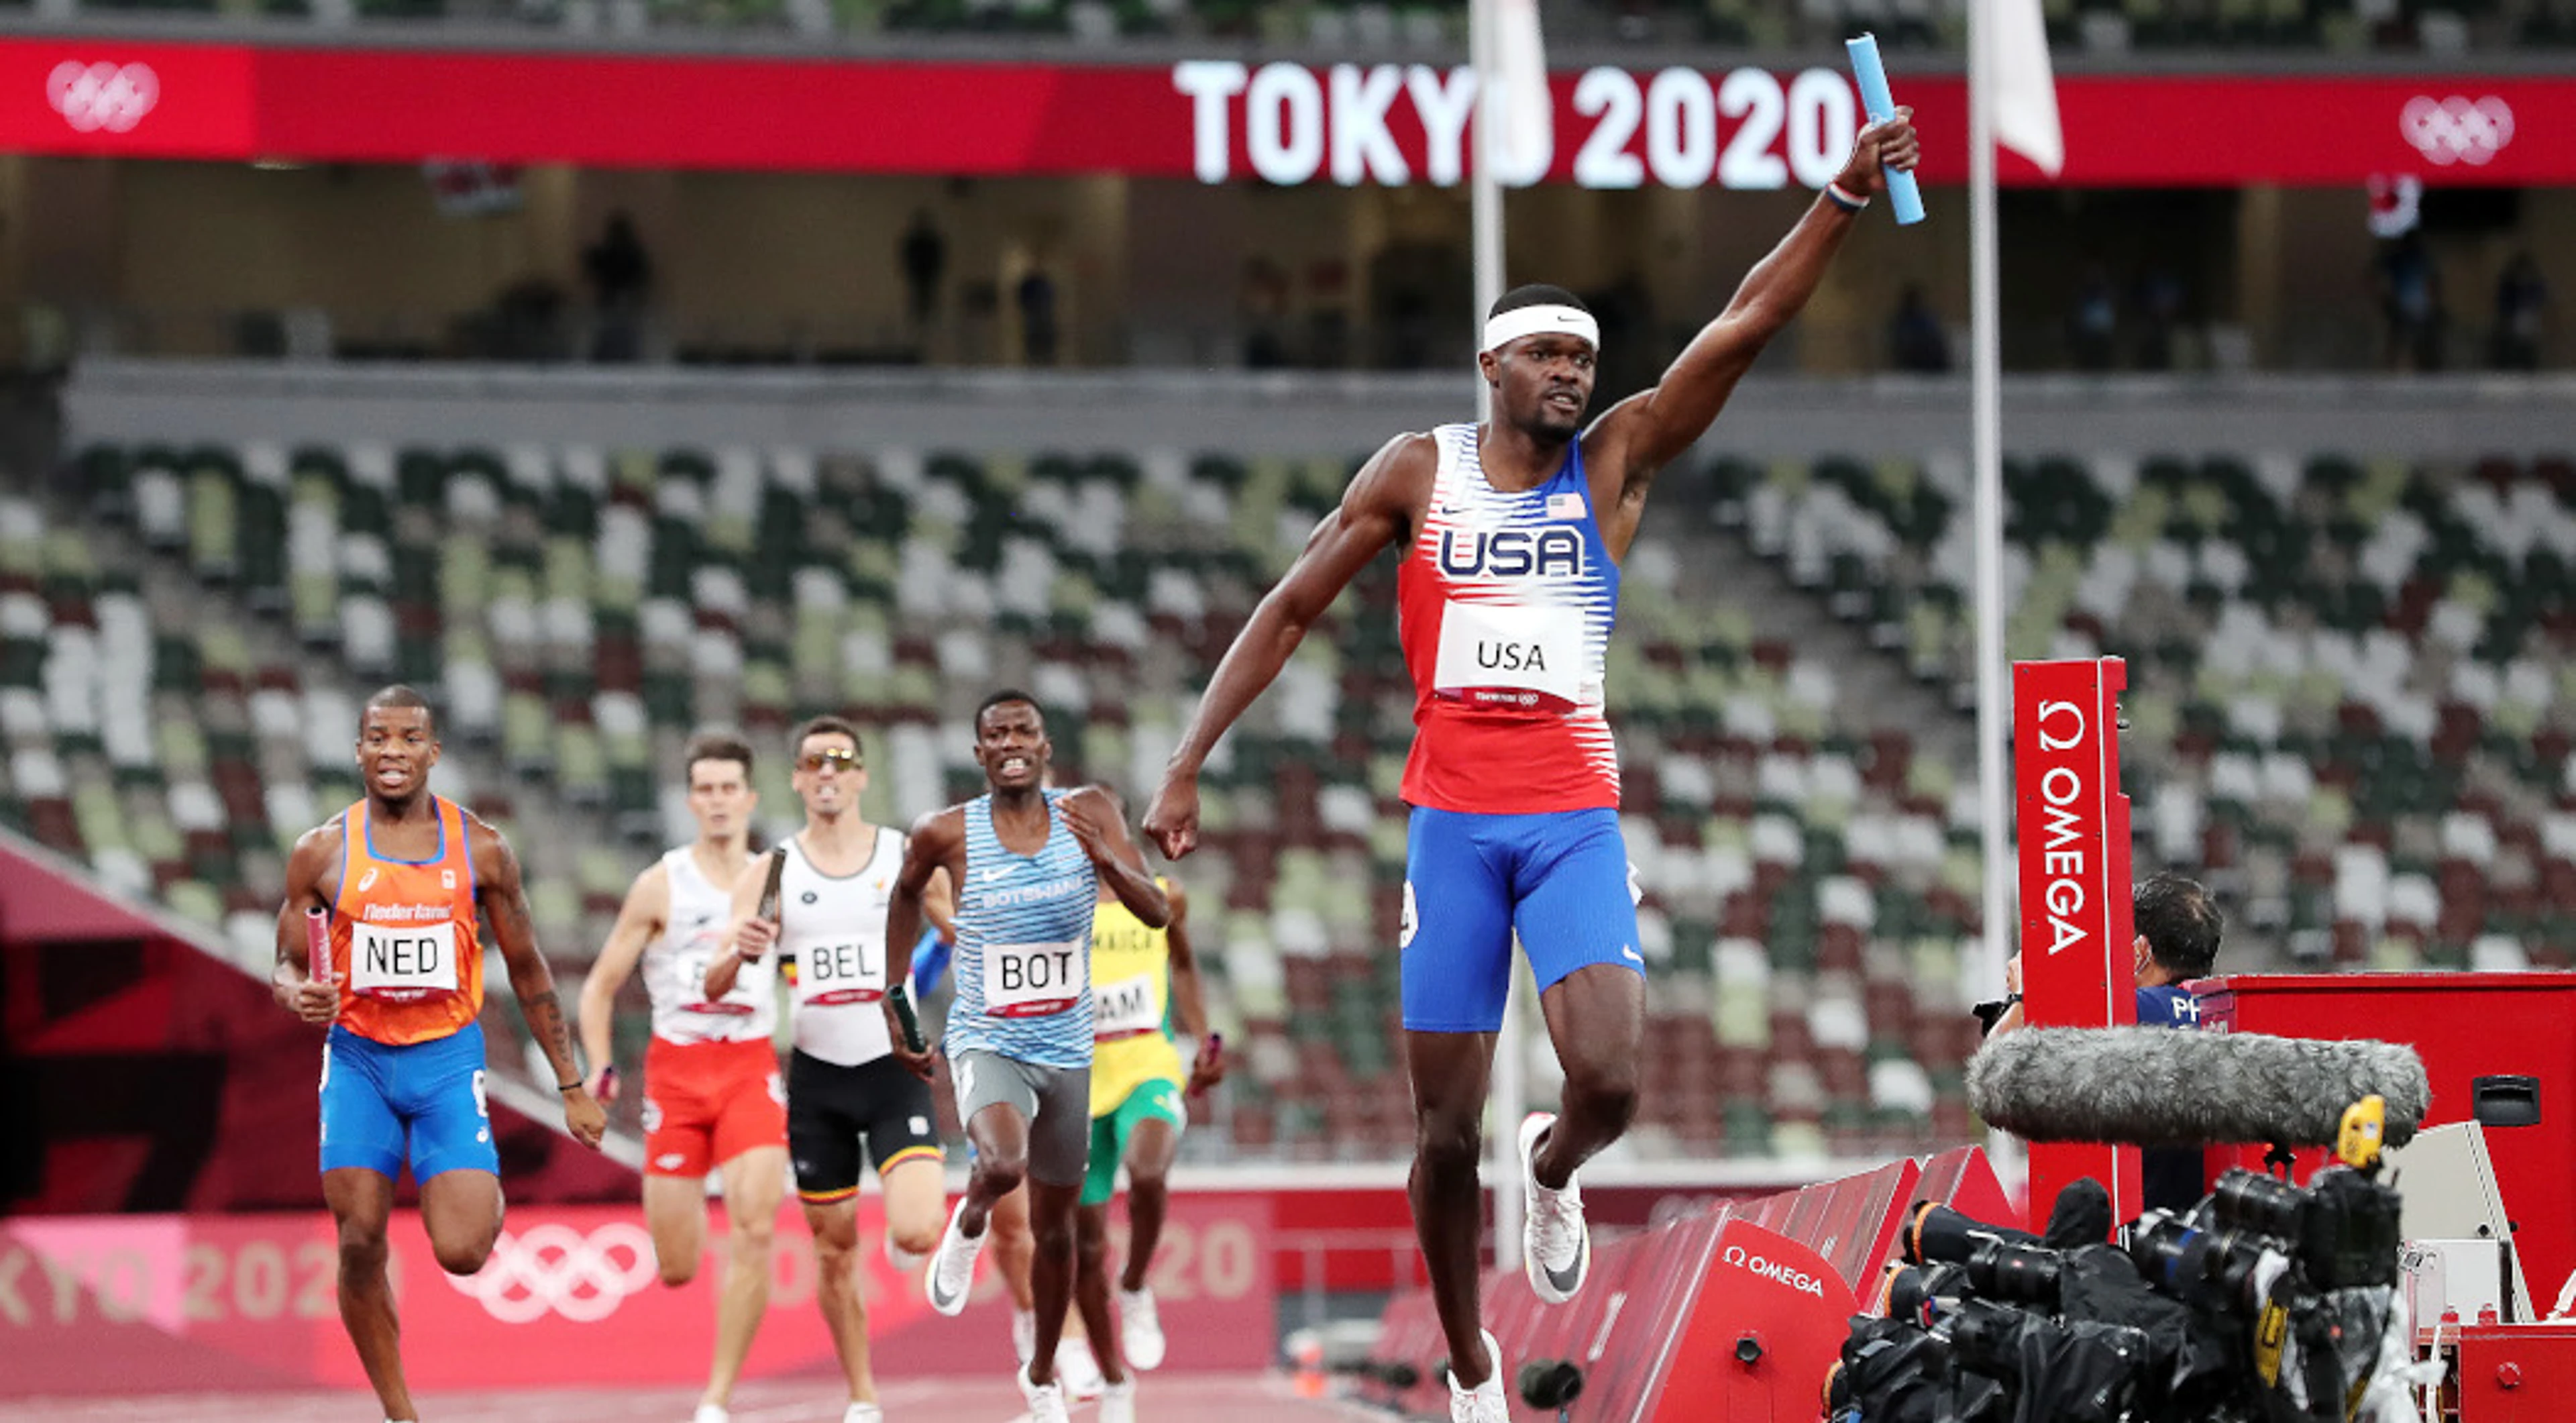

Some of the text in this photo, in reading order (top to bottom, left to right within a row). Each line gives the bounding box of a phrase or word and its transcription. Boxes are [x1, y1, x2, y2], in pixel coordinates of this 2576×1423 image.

[1172, 60, 1856, 189] TOKYO 2020
[1440, 528, 1583, 578] USA
[1477, 641, 1546, 672] USA
[2041, 767, 2088, 955] OMEGA
[983, 876, 1084, 909] BOTSWAN
[367, 937, 438, 975] NED
[813, 944, 877, 980] BEL
[1002, 951, 1073, 990] BOT
[1095, 988, 1146, 1020] AM
[181, 1240, 402, 1322] 202
[1748, 1255, 1824, 1298] OMEGA
